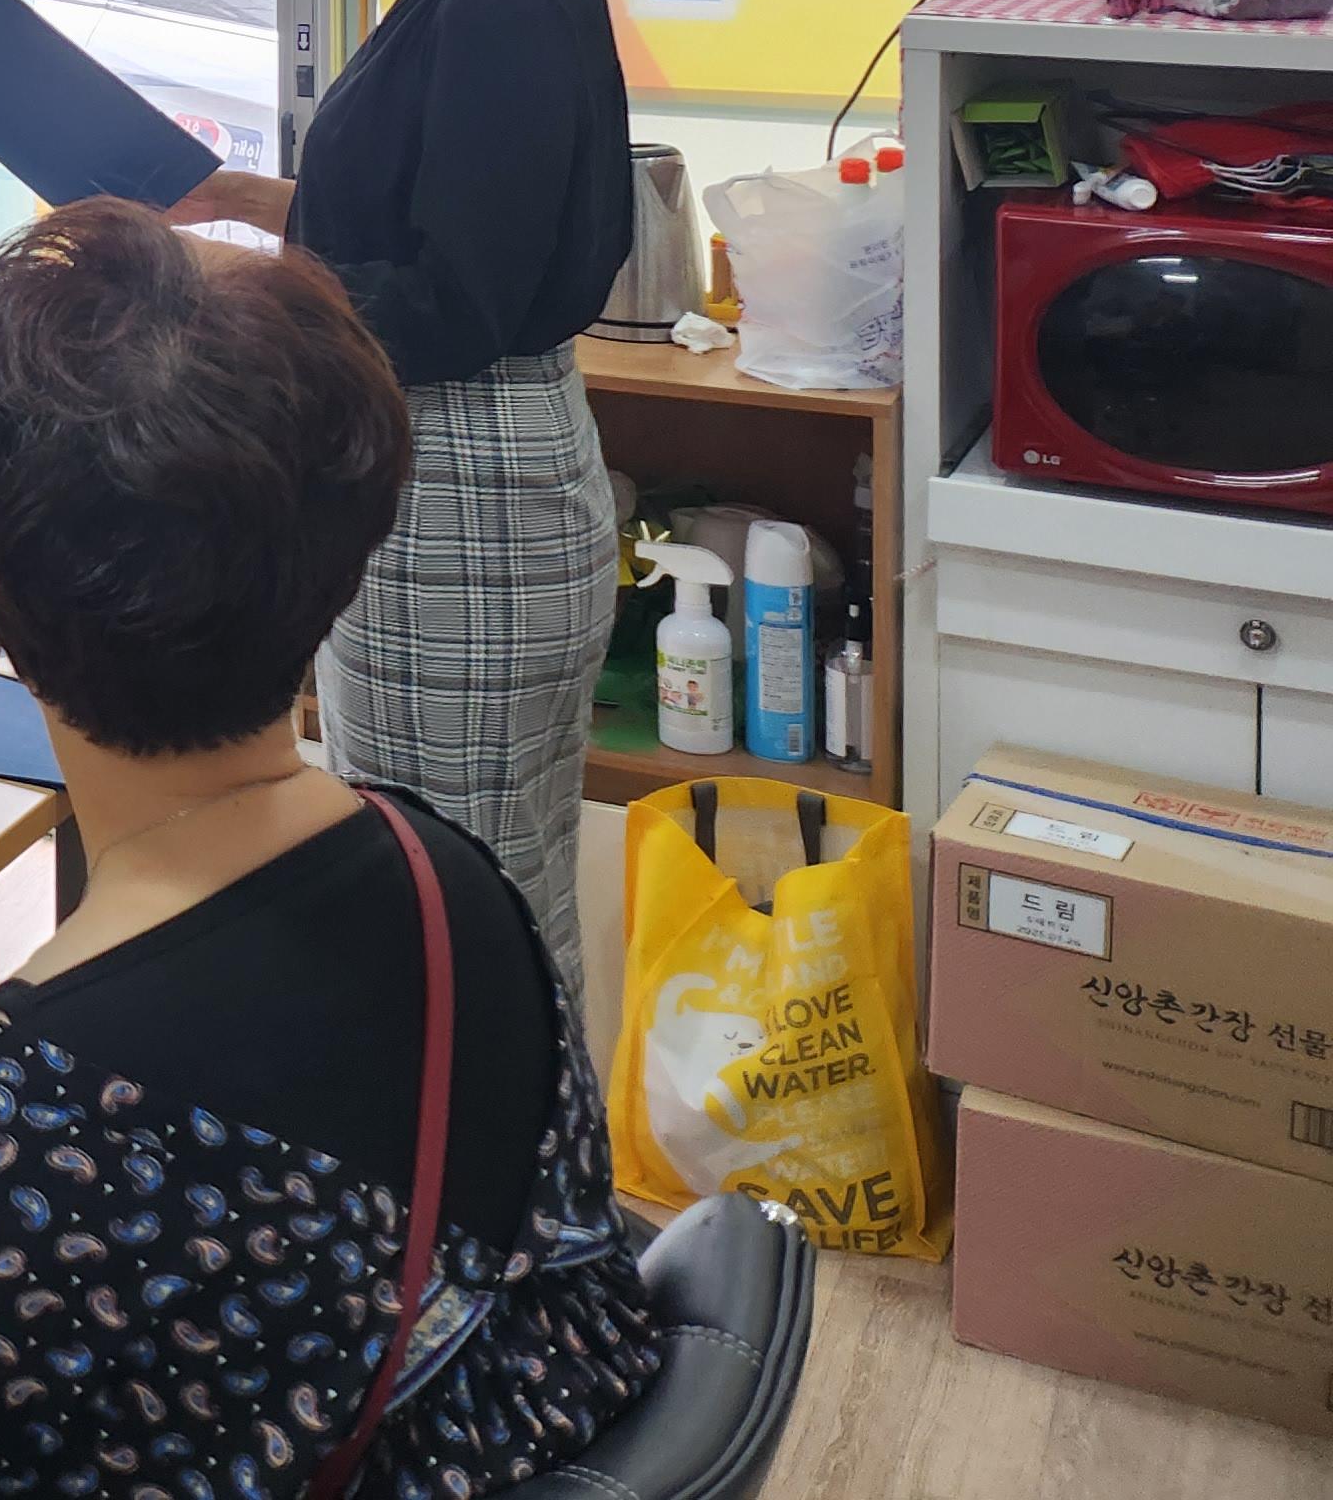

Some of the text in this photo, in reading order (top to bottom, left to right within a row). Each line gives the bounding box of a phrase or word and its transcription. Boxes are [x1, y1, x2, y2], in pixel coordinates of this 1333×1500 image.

[1042, 453, 1061, 466] LG
[760, 1018, 864, 1066] CLEAN
[742, 1052, 876, 1100] WATER.
